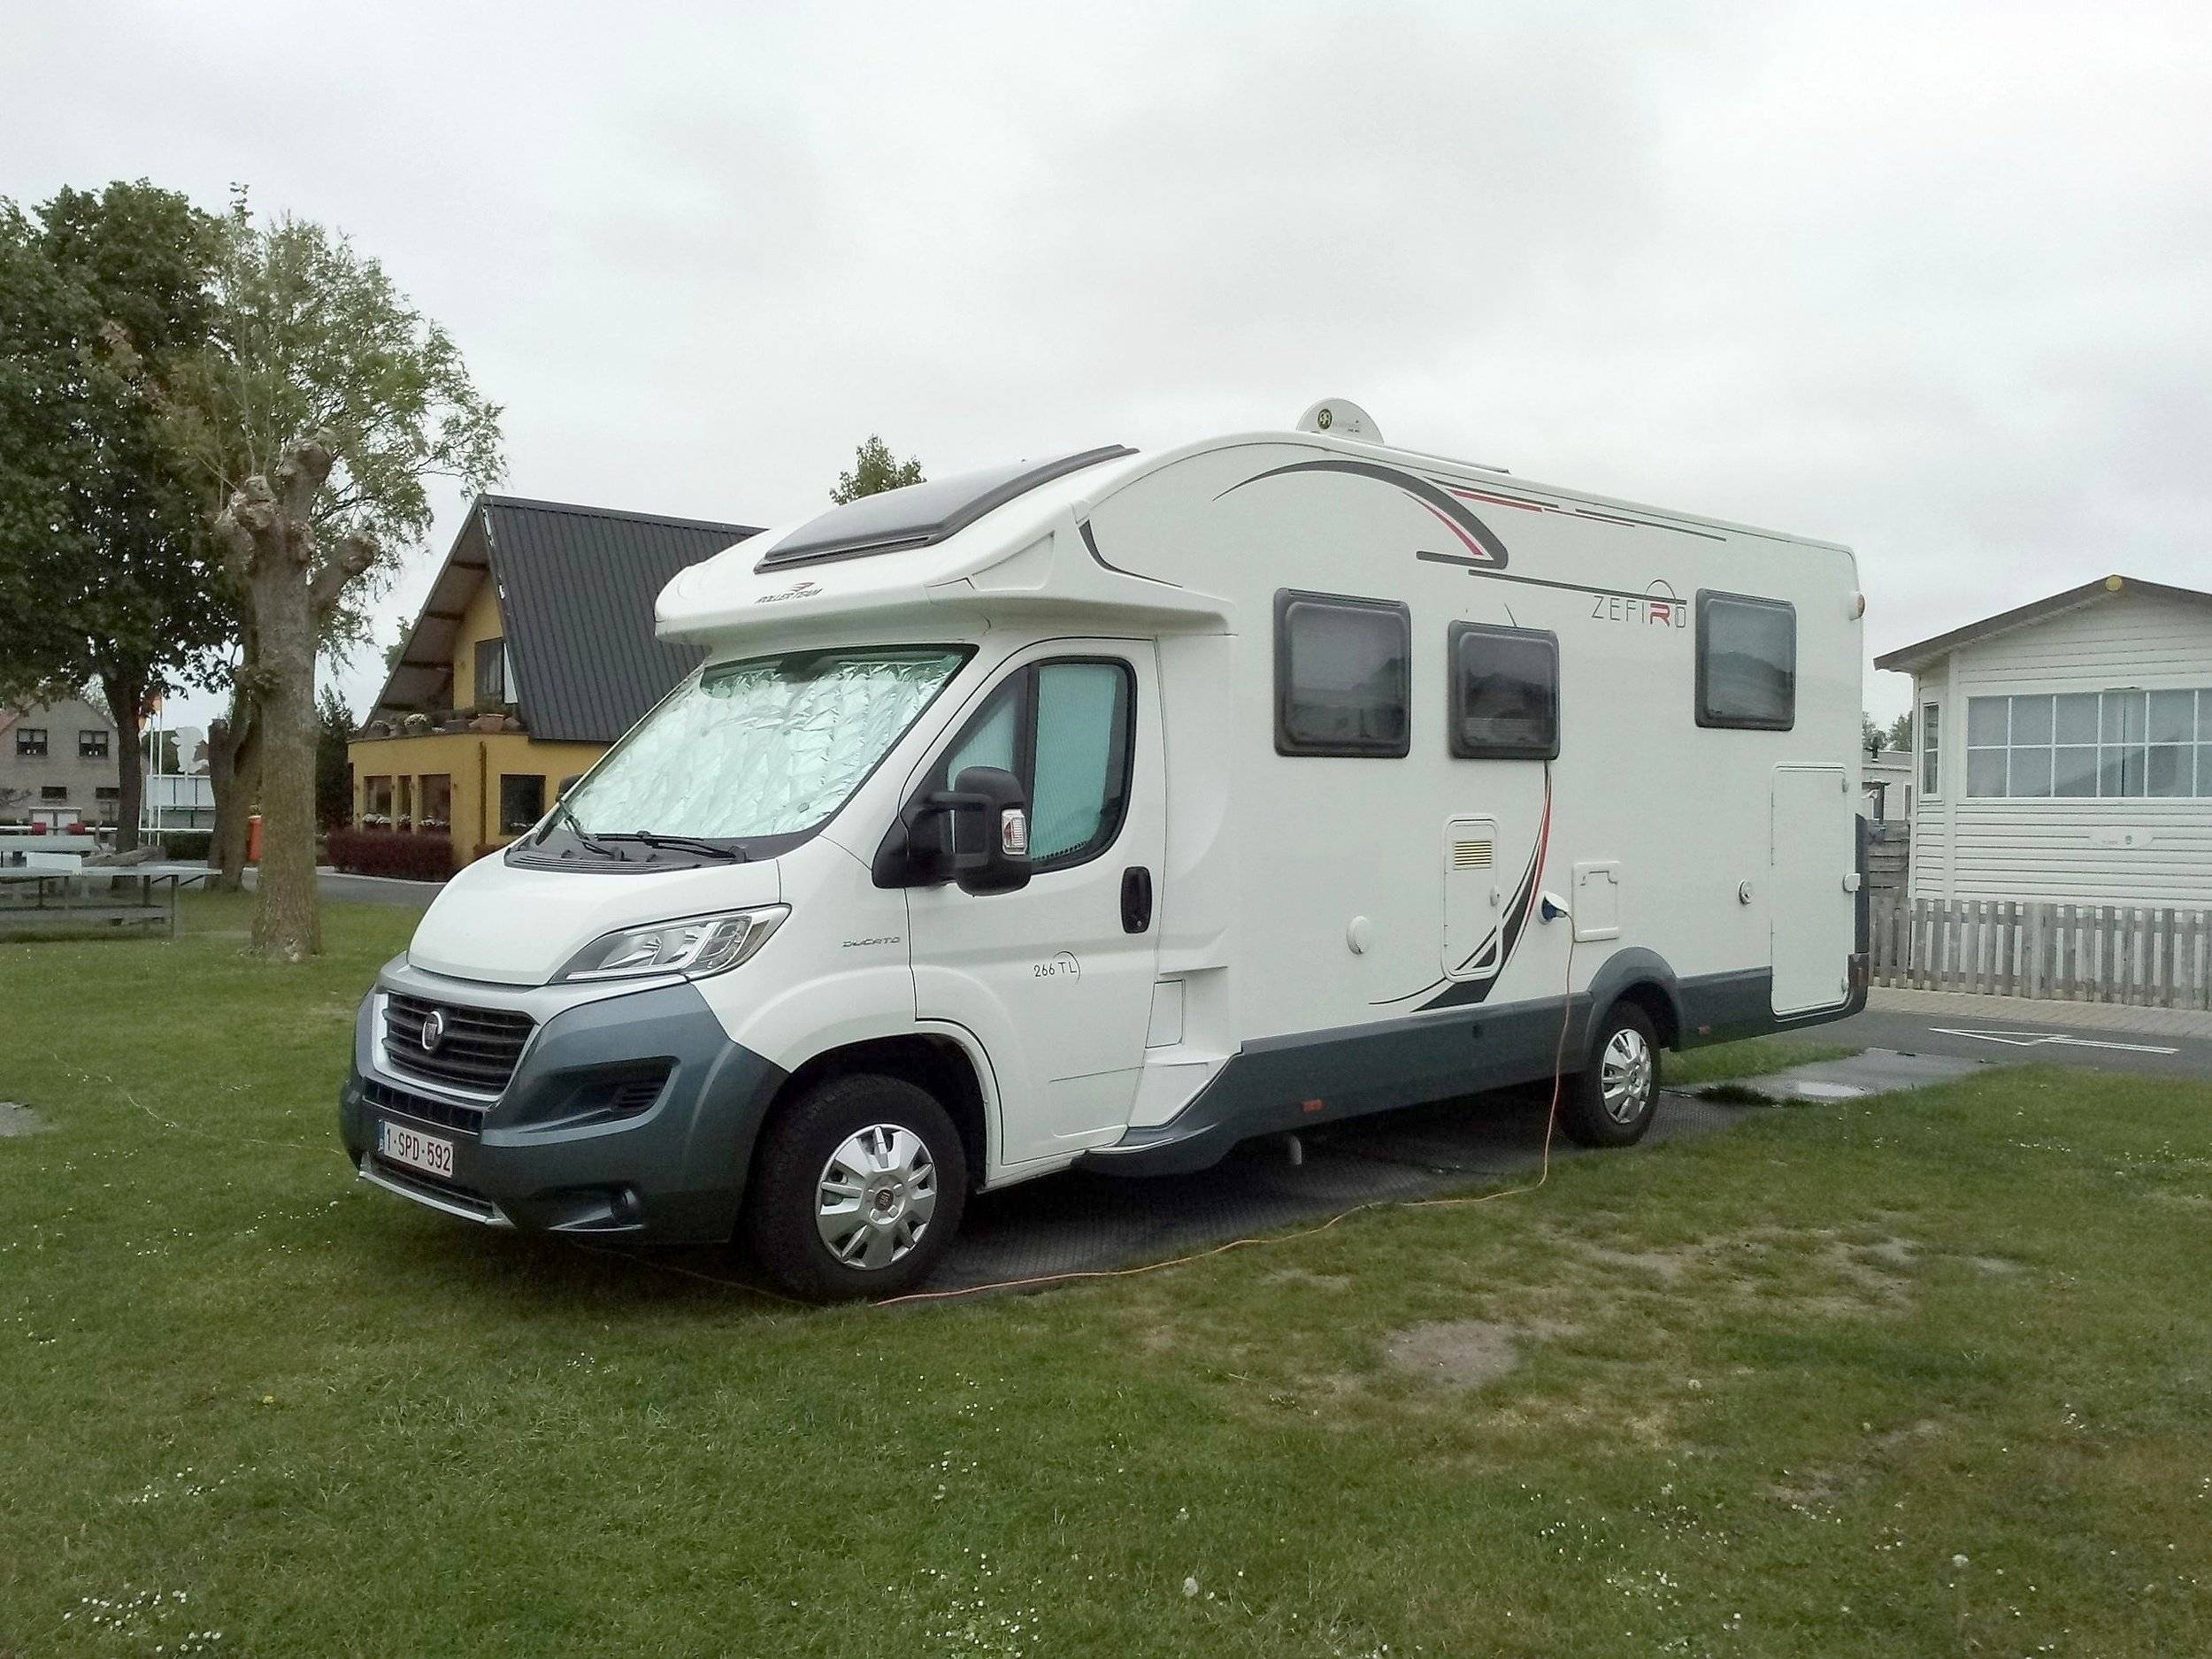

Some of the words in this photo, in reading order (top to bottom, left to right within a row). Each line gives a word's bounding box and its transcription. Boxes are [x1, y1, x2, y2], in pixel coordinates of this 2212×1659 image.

[1592, 595, 1686, 628] ZEFIRO
[1034, 964, 1056, 977] 266
[1057, 962, 1077, 974] TL
